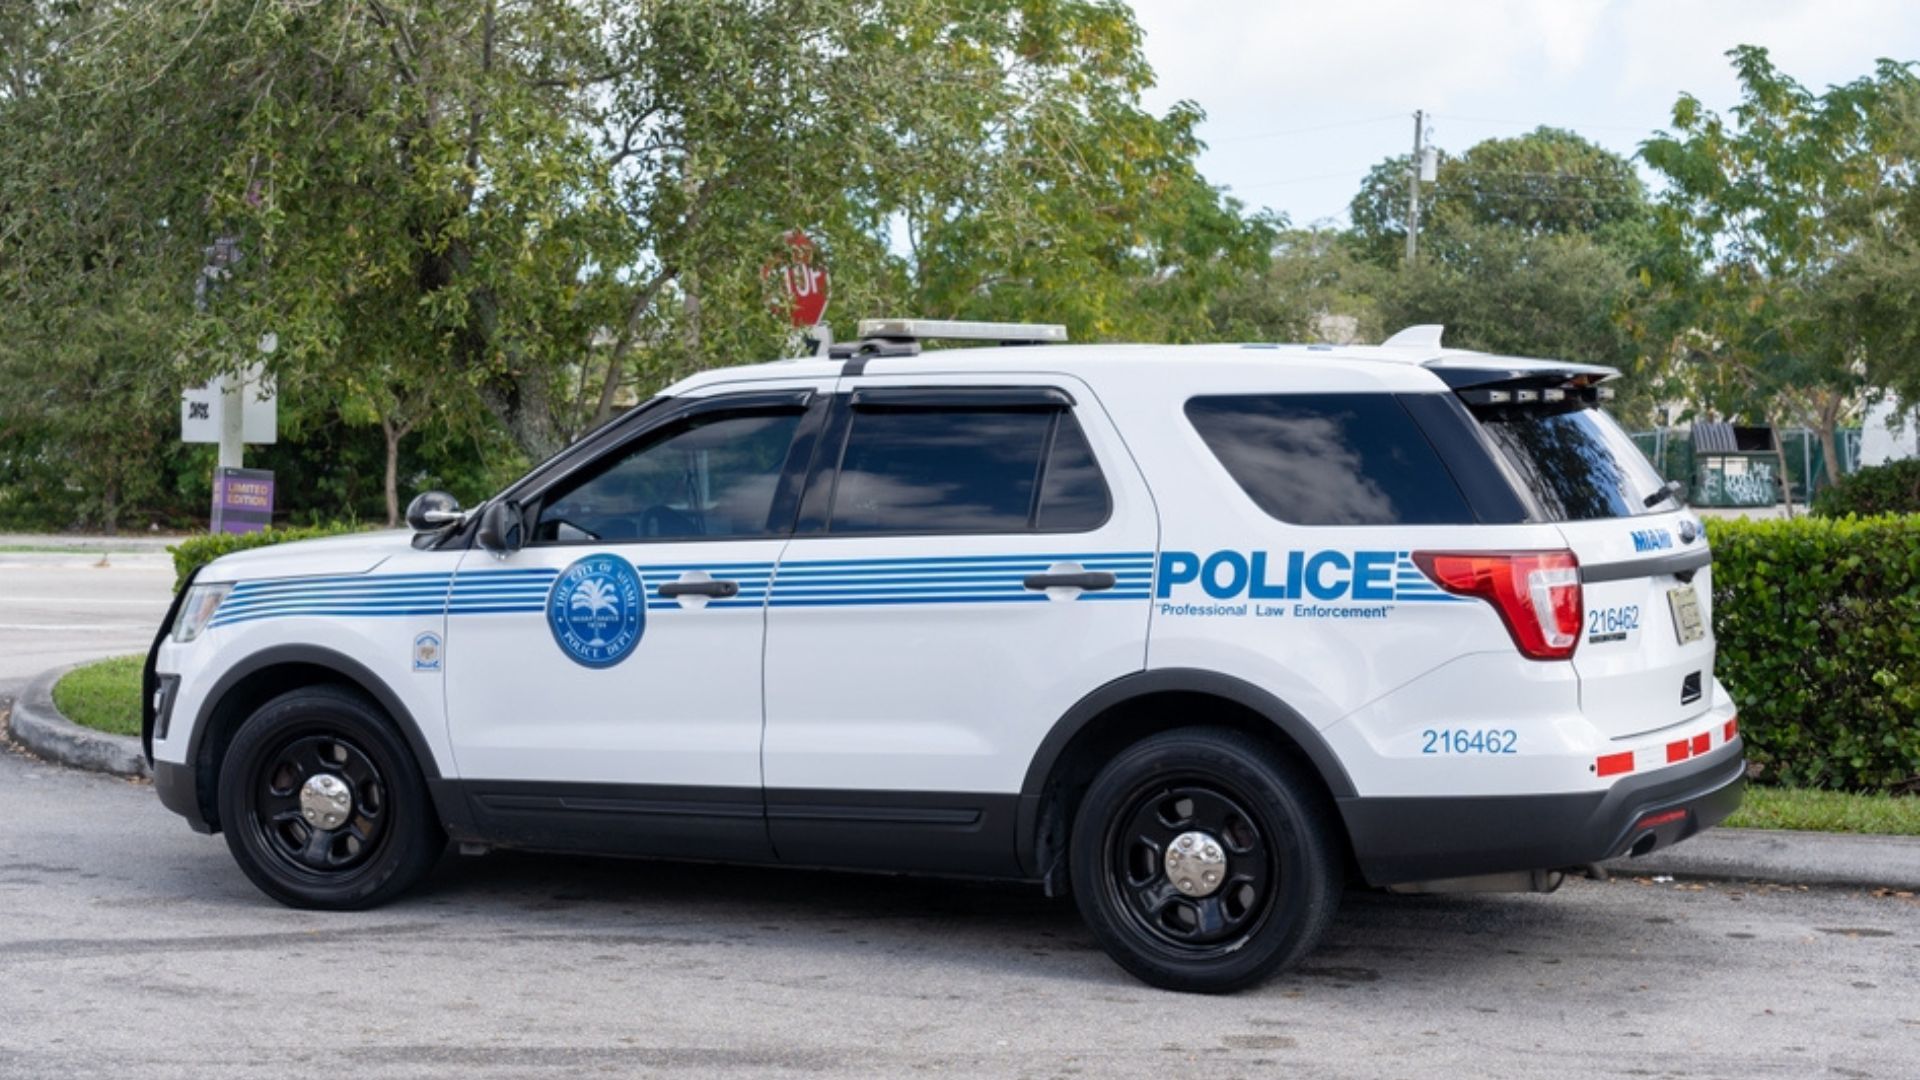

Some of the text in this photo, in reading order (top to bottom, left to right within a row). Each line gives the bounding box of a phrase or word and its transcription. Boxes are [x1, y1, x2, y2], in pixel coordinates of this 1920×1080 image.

[228, 483, 268, 496] LIMITED
[228, 494, 268, 506] EDITION
[1630, 529, 1673, 552] MIAMI
[571, 564, 593, 581] CITY
[599, 563, 613, 573] OF
[1157, 549, 1397, 600] POLICE
[1256, 604, 1284, 617] Law
[1589, 605, 1639, 633] 216462
[564, 632, 600, 658] POLICE
[1422, 729, 1517, 753] 216462
